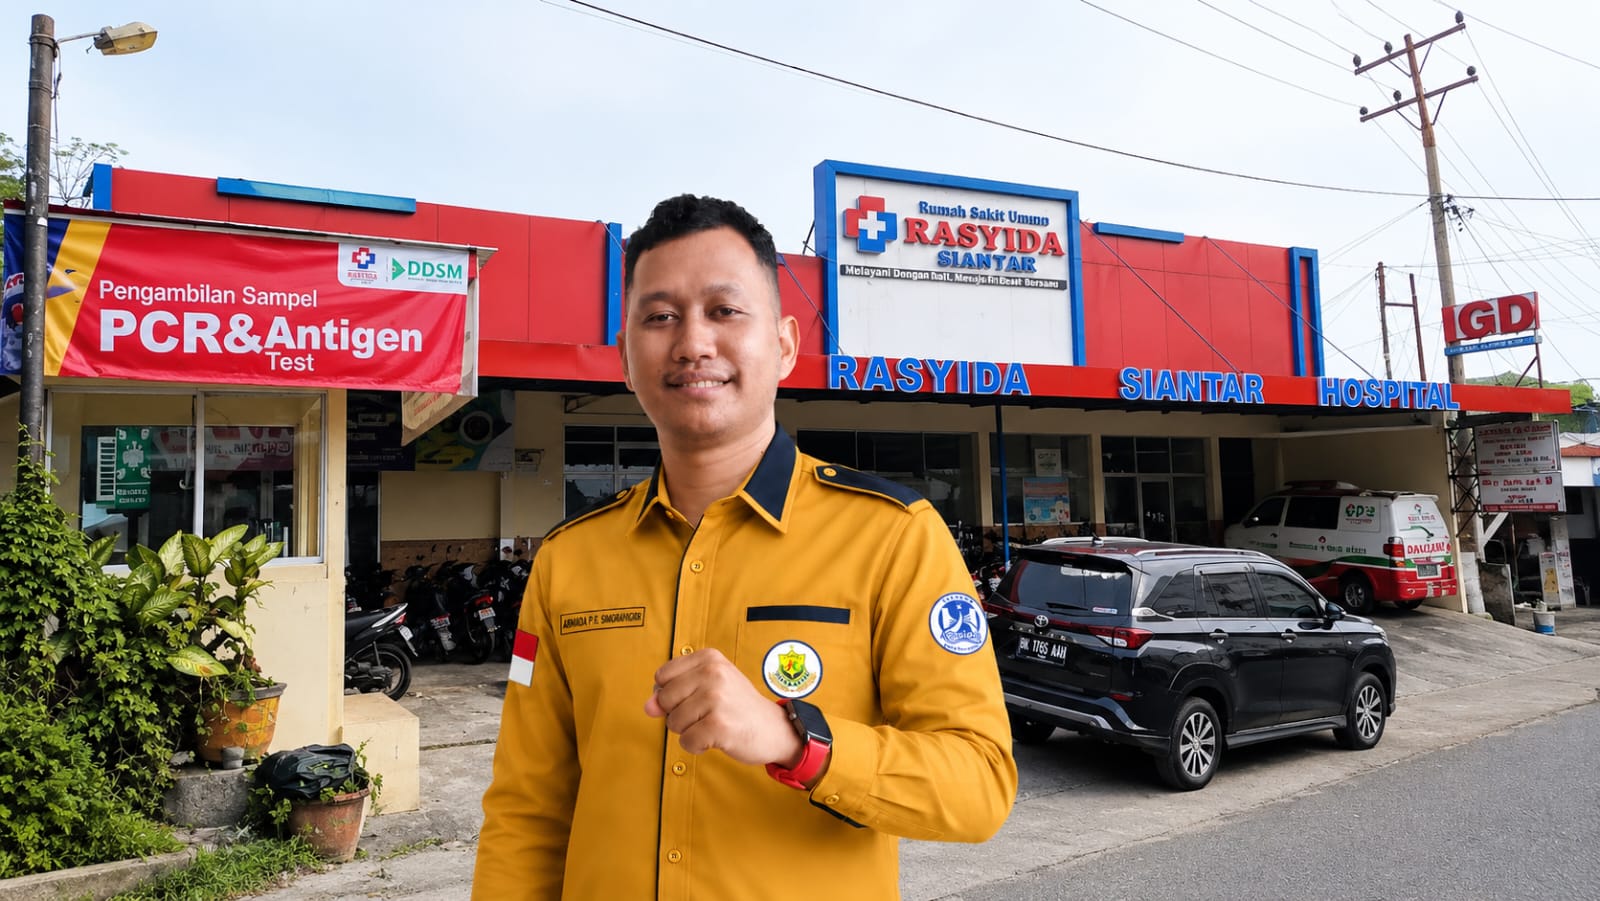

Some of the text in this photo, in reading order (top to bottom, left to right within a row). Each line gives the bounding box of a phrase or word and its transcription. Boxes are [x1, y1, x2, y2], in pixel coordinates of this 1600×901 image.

[918, 201, 967, 218] Rumah
[970, 207, 1005, 223] Sakit
[904, 217, 1065, 257] RASYIDA
[408, 260, 462, 280] DDSM
[937, 250, 1038, 273] SIANTAR
[99, 280, 318, 311] Pengambilan Sampel
[1442, 295, 1535, 343] IGD
[265, 351, 315, 371] Test
[829, 354, 1460, 410] RASYIDA SIANTAR HOSPITAL
